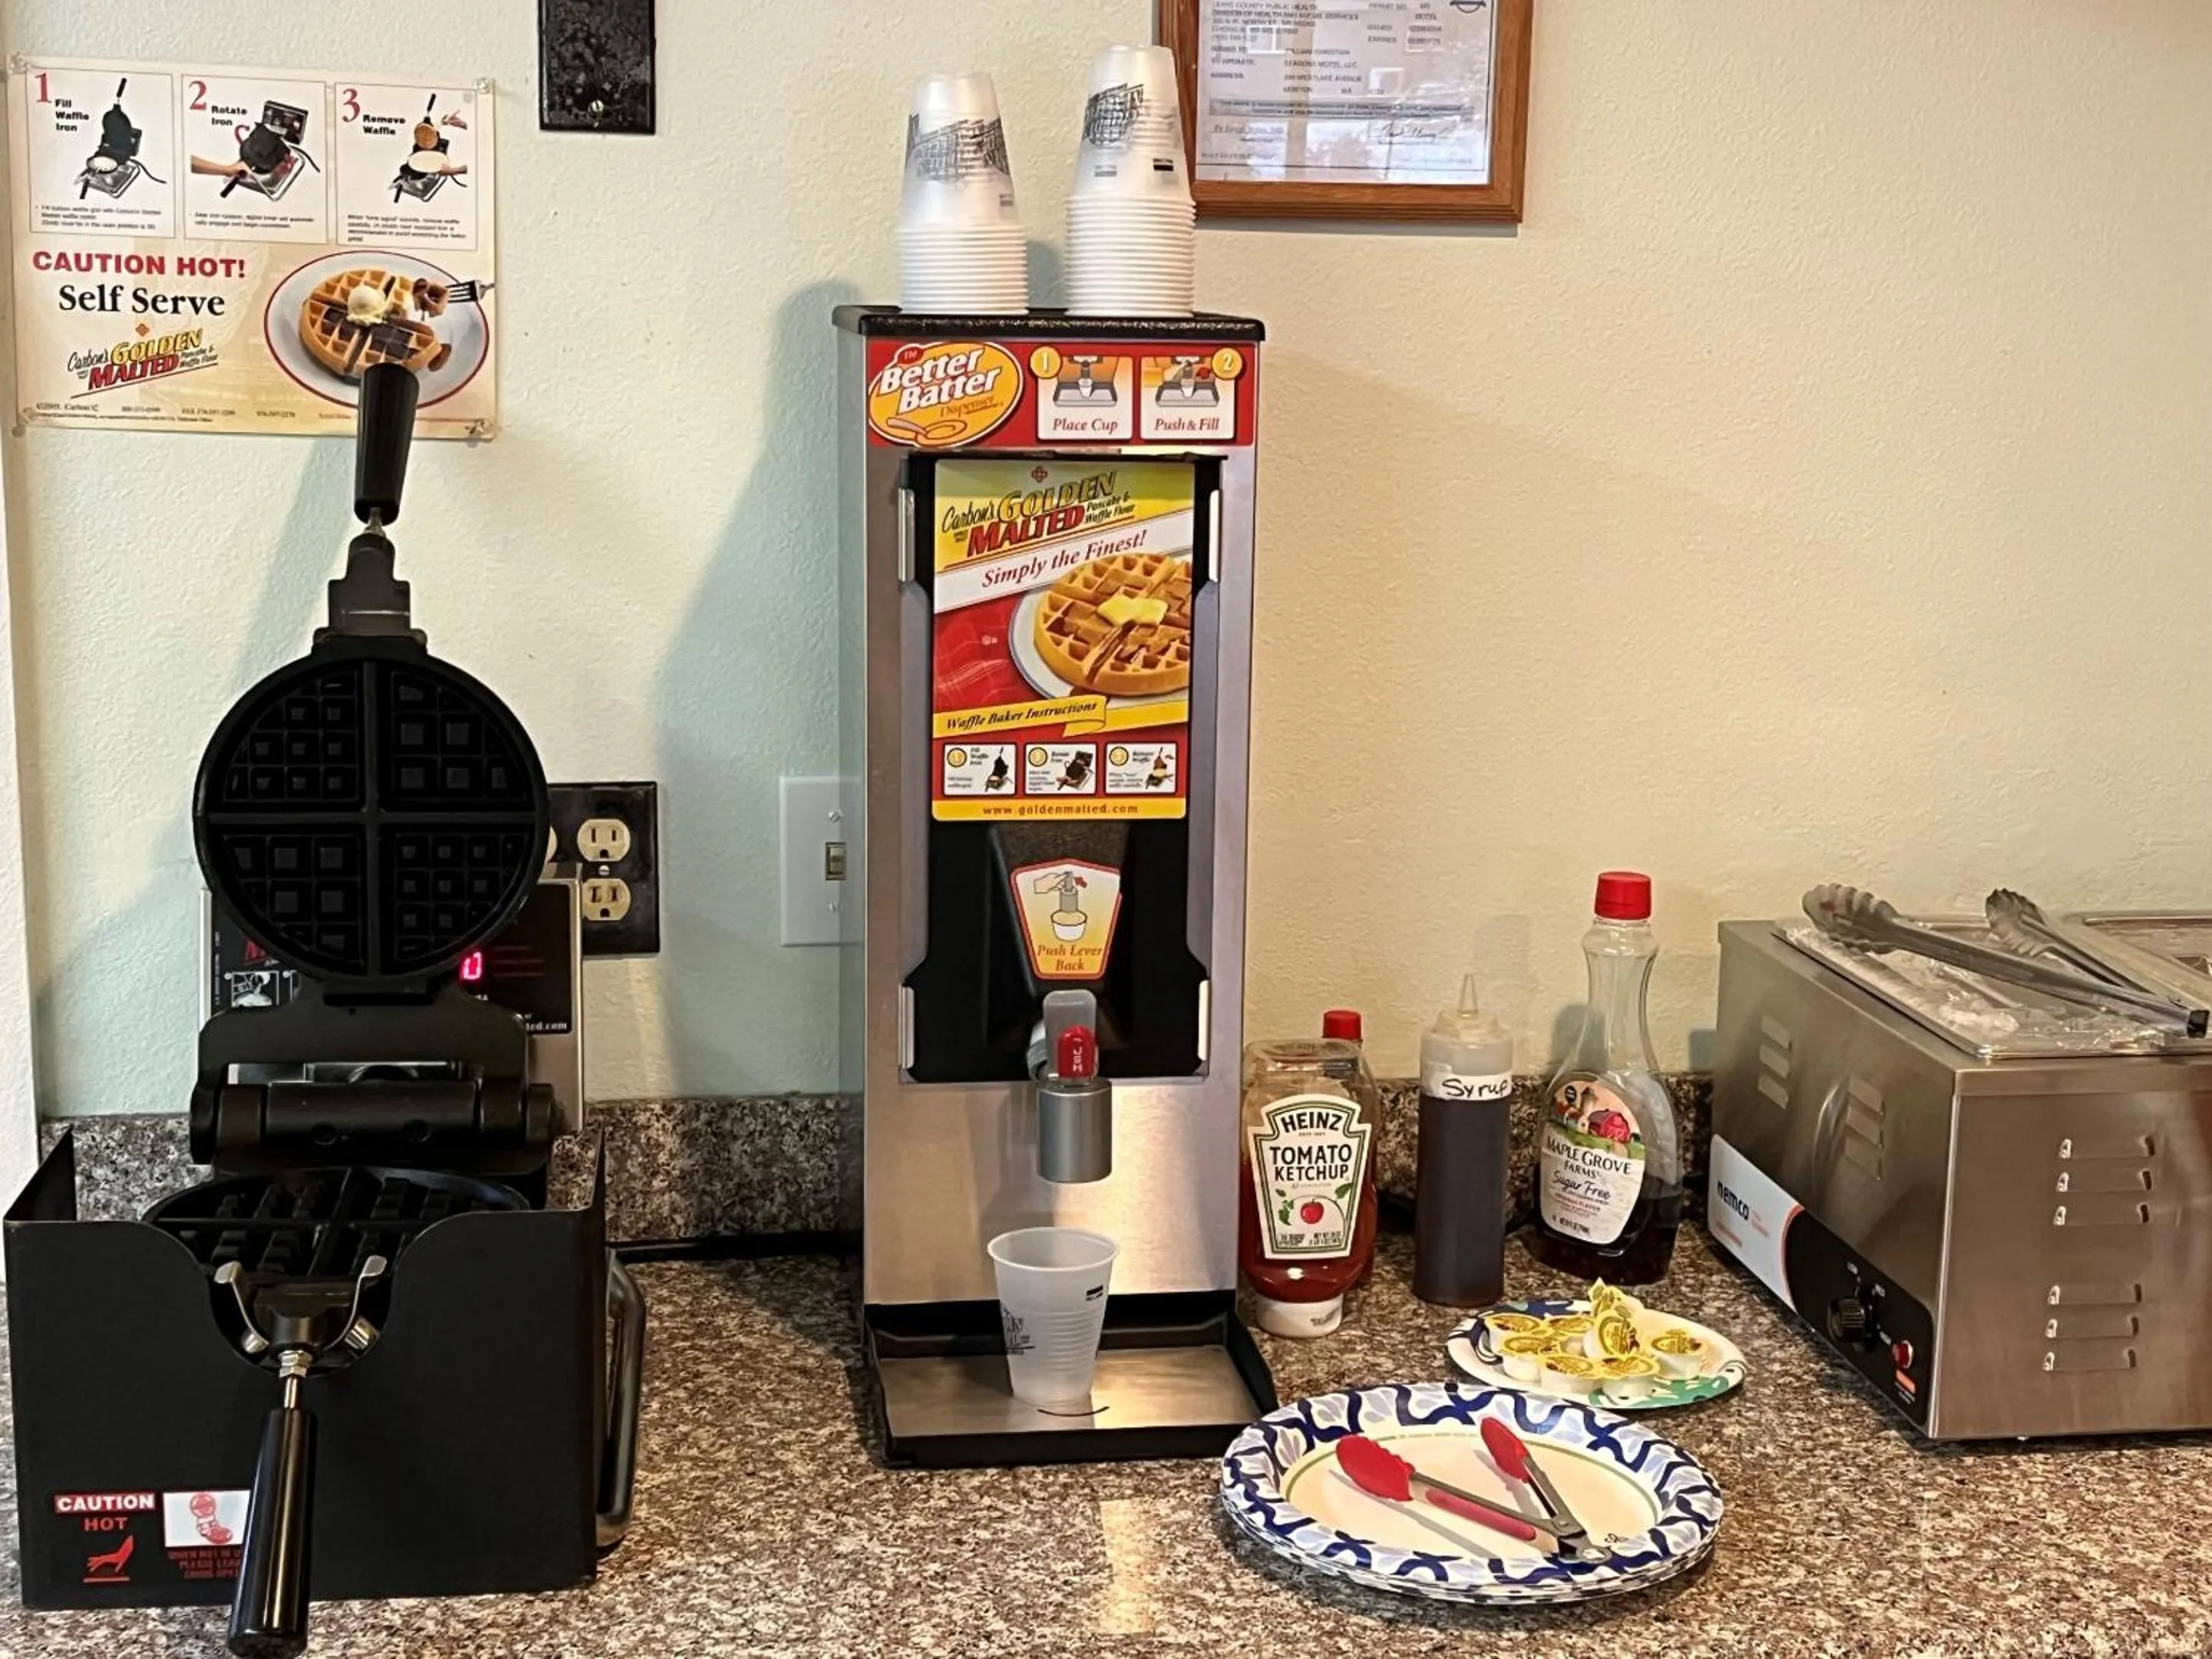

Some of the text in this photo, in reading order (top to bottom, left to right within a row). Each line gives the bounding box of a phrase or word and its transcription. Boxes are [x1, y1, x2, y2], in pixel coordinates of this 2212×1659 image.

[35, 73, 51, 103] 1
[189, 80, 207, 111] 2
[55, 98, 72, 108] Fill
[211, 105, 248, 115] Rotate
[342, 88, 360, 123] 3
[55, 111, 89, 121] Waffle
[211, 117, 233, 126] Iron
[362, 114, 406, 124] Remove
[55, 122, 78, 132] Iron
[362, 125, 396, 136] Waffle
[33, 251, 246, 278] CAUTION HOT!
[58, 284, 225, 316] Self Serve
[110, 328, 203, 367] GOLDEN
[88, 354, 180, 390] MALTED
[878, 347, 985, 396] Better
[1040, 352, 1050, 373] 1
[1221, 352, 1234, 373] 2
[898, 366, 1003, 415] Batter
[941, 397, 994, 417] Dispenser
[1053, 418, 1119, 433] Place Cup
[1154, 418, 1185, 431] Push
[1199, 418, 1220, 431] Fill
[998, 470, 1117, 523] GOLDEN
[967, 505, 1086, 558] MALTED
[982, 530, 1148, 588] Simply the Finest!
[946, 701, 1098, 731] Waffle Baker Instructions
[982, 803, 1139, 817] www.goldenmalted.com
[1037, 944, 1103, 957] Push Lever
[1055, 958, 1085, 972] Back
[1442, 1078, 1508, 1098] Syrup
[1281, 1112, 1344, 1133] HEINZ
[1269, 1143, 1353, 1165] TOMATO
[1546, 1135, 1633, 1175] MAPLE GROVE
[1275, 1164, 1349, 1182] KETCHUP
[1564, 1160, 1597, 1179] FARMS
[1552, 1170, 1612, 1199] Sugar Free
[1717, 1179, 1750, 1221] nemco
[57, 1494, 154, 1512] CAUTION
[84, 1516, 129, 1532] HOT
